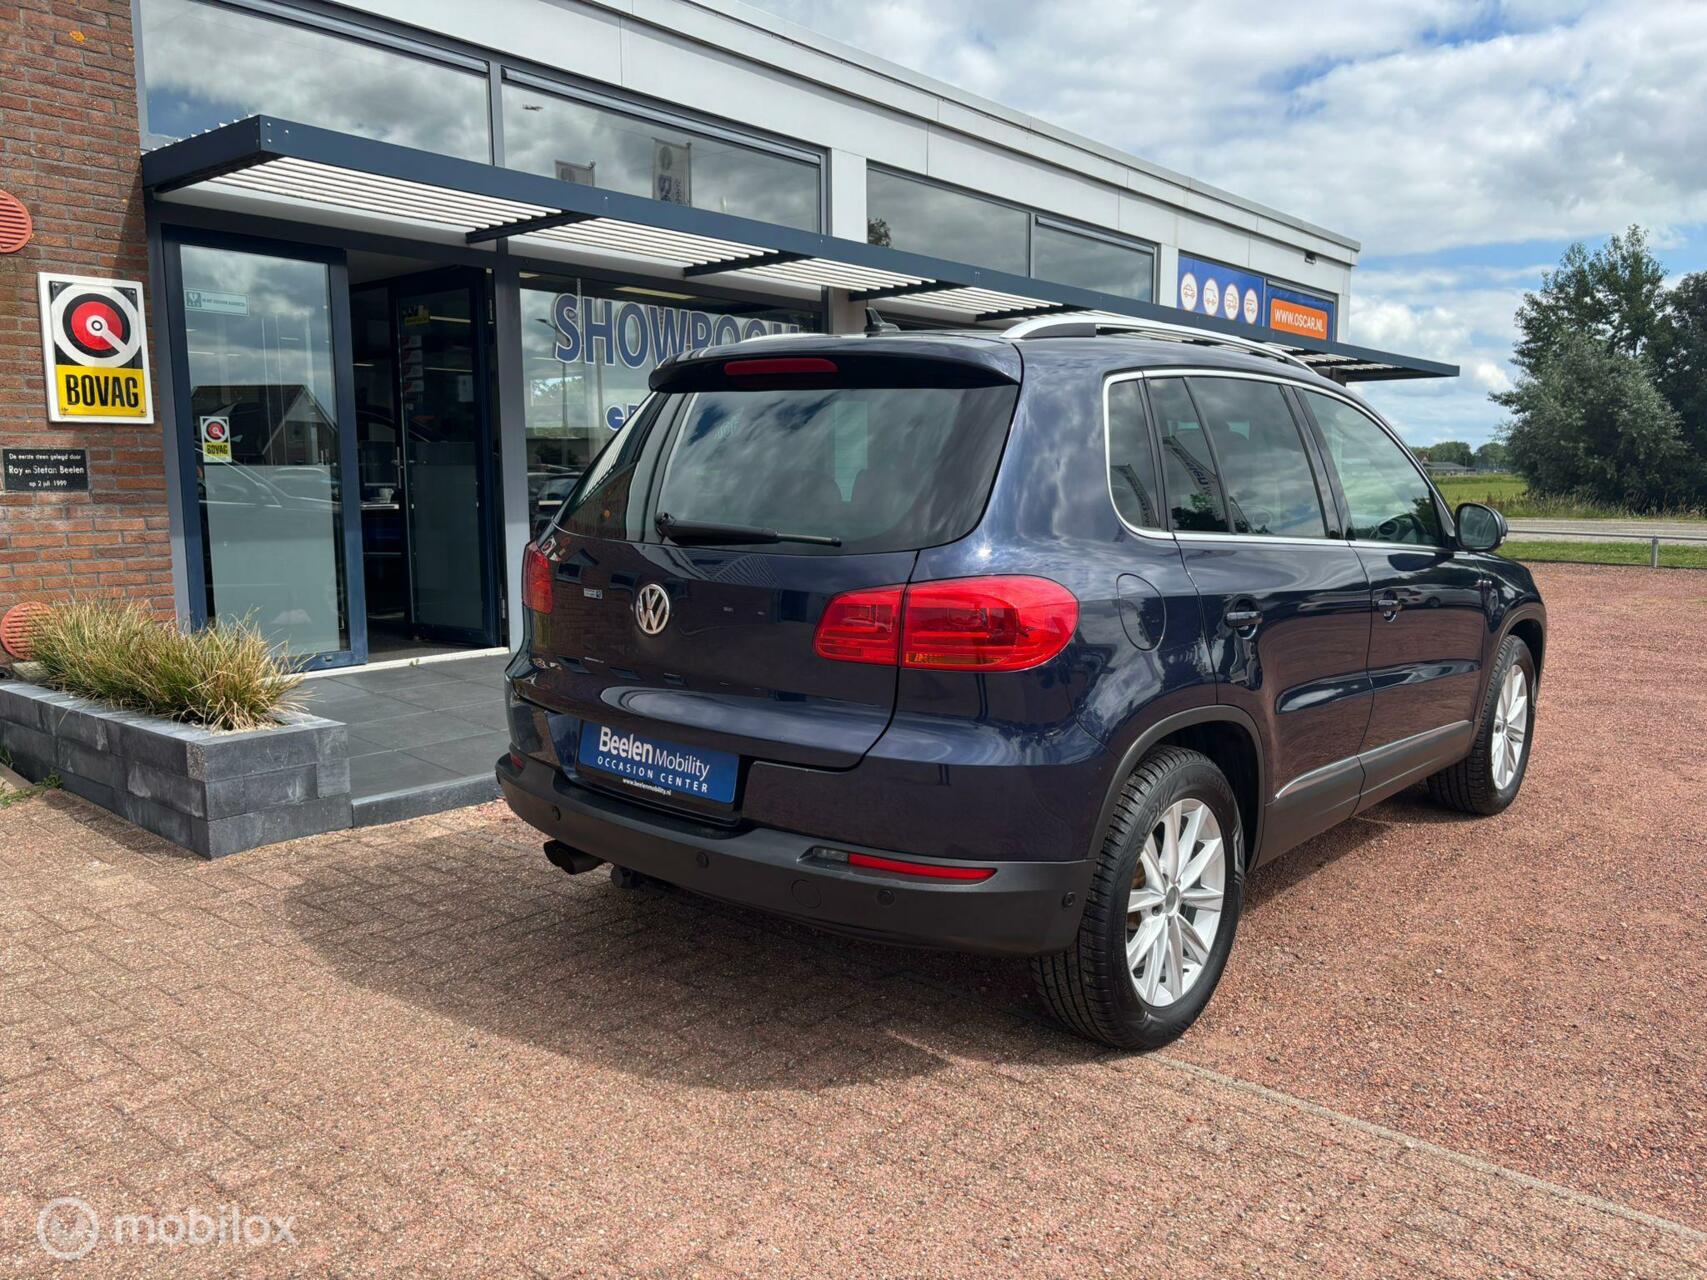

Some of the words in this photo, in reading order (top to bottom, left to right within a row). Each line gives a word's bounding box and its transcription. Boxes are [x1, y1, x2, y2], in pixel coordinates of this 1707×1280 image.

[1274, 308, 1324, 332] WWW.OSCAR.NL
[65, 374, 138, 408] BOVAG
[8, 465, 23, 476] Roy
[33, 465, 58, 474] Stefan
[60, 465, 85, 474] Beelen
[598, 726, 653, 764] Beelen
[655, 748, 710, 781] Mobility
[597, 755, 653, 779] OCCASION
[660, 772, 709, 793] CENTER
